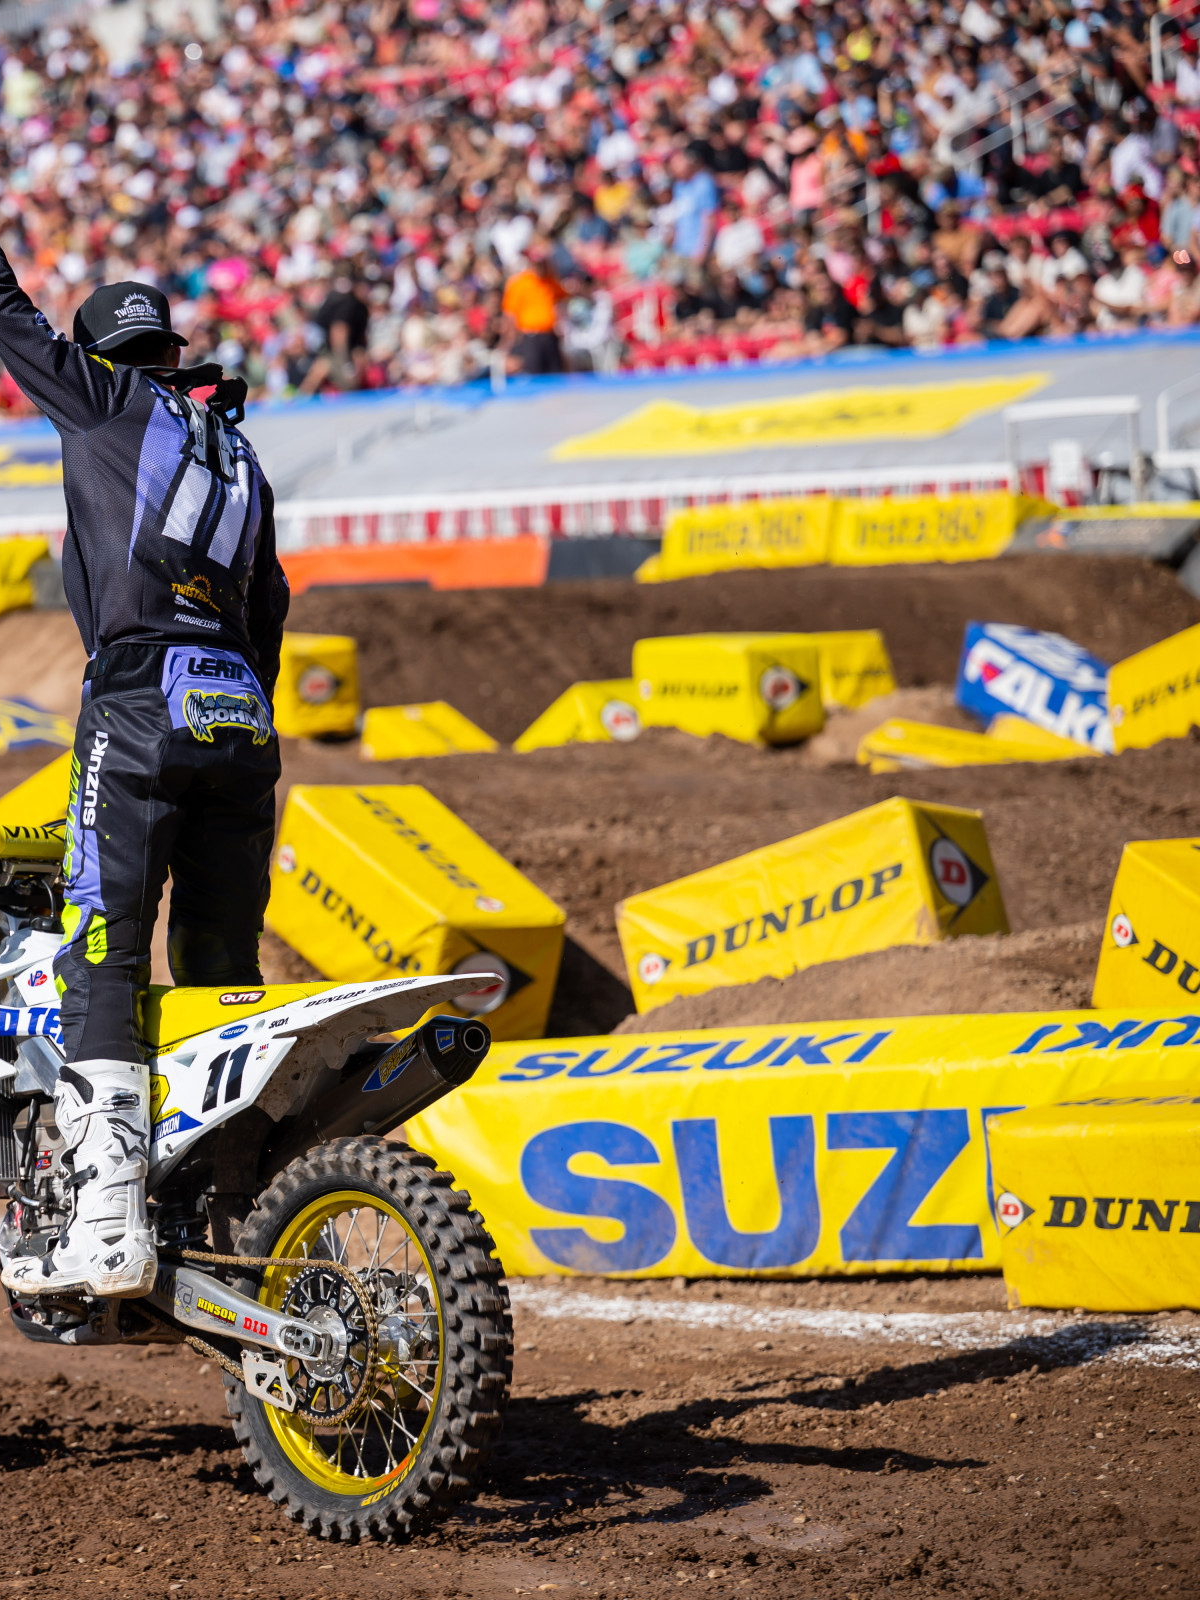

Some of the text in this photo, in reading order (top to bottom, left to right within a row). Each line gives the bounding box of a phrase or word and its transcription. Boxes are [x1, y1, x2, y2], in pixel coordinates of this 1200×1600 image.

[114, 304, 146, 319] TWISTED
[145, 304, 158, 317] TEA
[171, 582, 210, 603] TWISTED
[174, 613, 221, 631] PROGRESSIVE
[200, 708, 259, 729] JOHN
[82, 730, 109, 827] SUZUKI
[938, 859, 968, 887] D
[300, 869, 422, 974] DUNLOP
[683, 863, 904, 969] DUNLOP
[30, 970, 44, 987] VP
[220, 991, 263, 1004] GUTS
[302, 989, 367, 1009] DUNLOP
[1008, 1014, 1200, 1055] UKI
[499, 1029, 896, 1083] SUZUKI
[201, 1042, 256, 1114] 11
[519, 1104, 1027, 1273] SUZ
[1002, 1203, 1021, 1217] D
[196, 1297, 238, 1322] HINSON
[360, 1456, 417, 1507] DUNLOP
